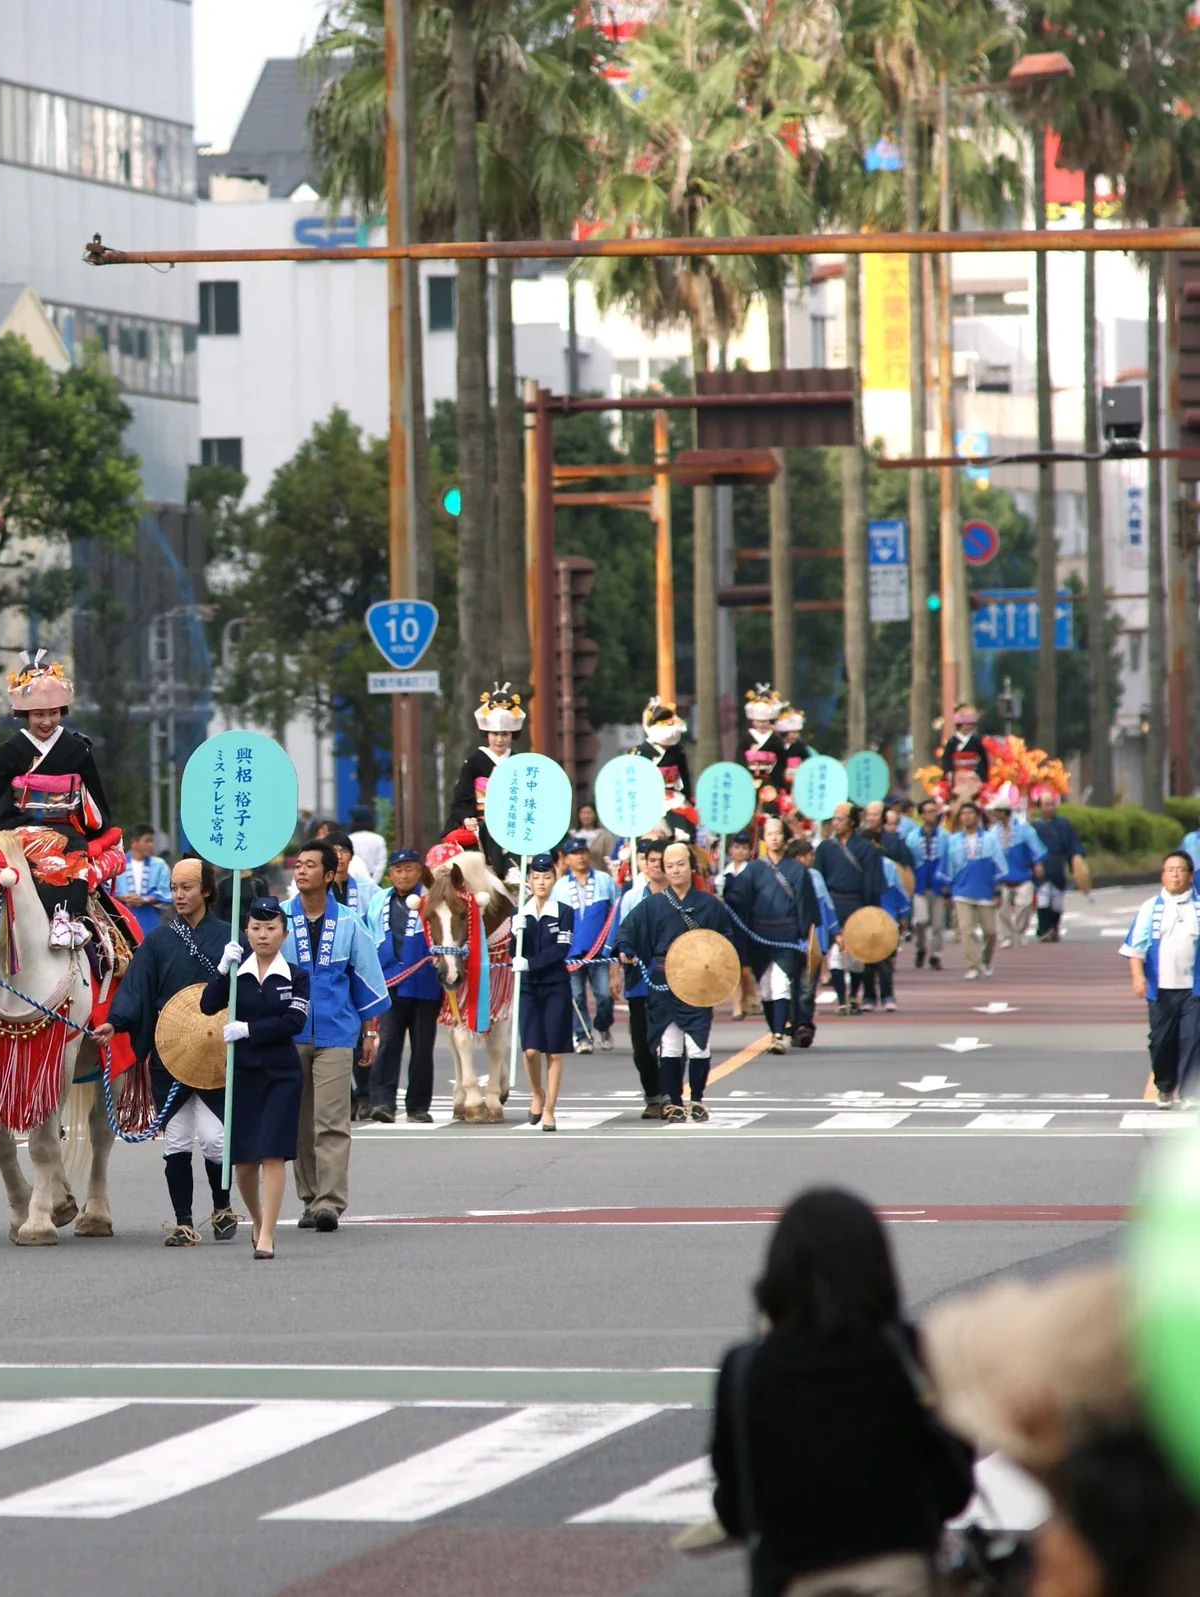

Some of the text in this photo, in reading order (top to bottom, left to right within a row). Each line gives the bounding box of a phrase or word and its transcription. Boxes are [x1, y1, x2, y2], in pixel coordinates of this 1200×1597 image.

[883, 253, 908, 384] 太陽銀行
[384, 617, 420, 642] 10
[234, 747, 253, 851] 興梠 裕子さん
[525, 766, 540, 792] 野中
[293, 915, 311, 962] 宮崎交通
[319, 919, 336, 966] 宮崎交通
